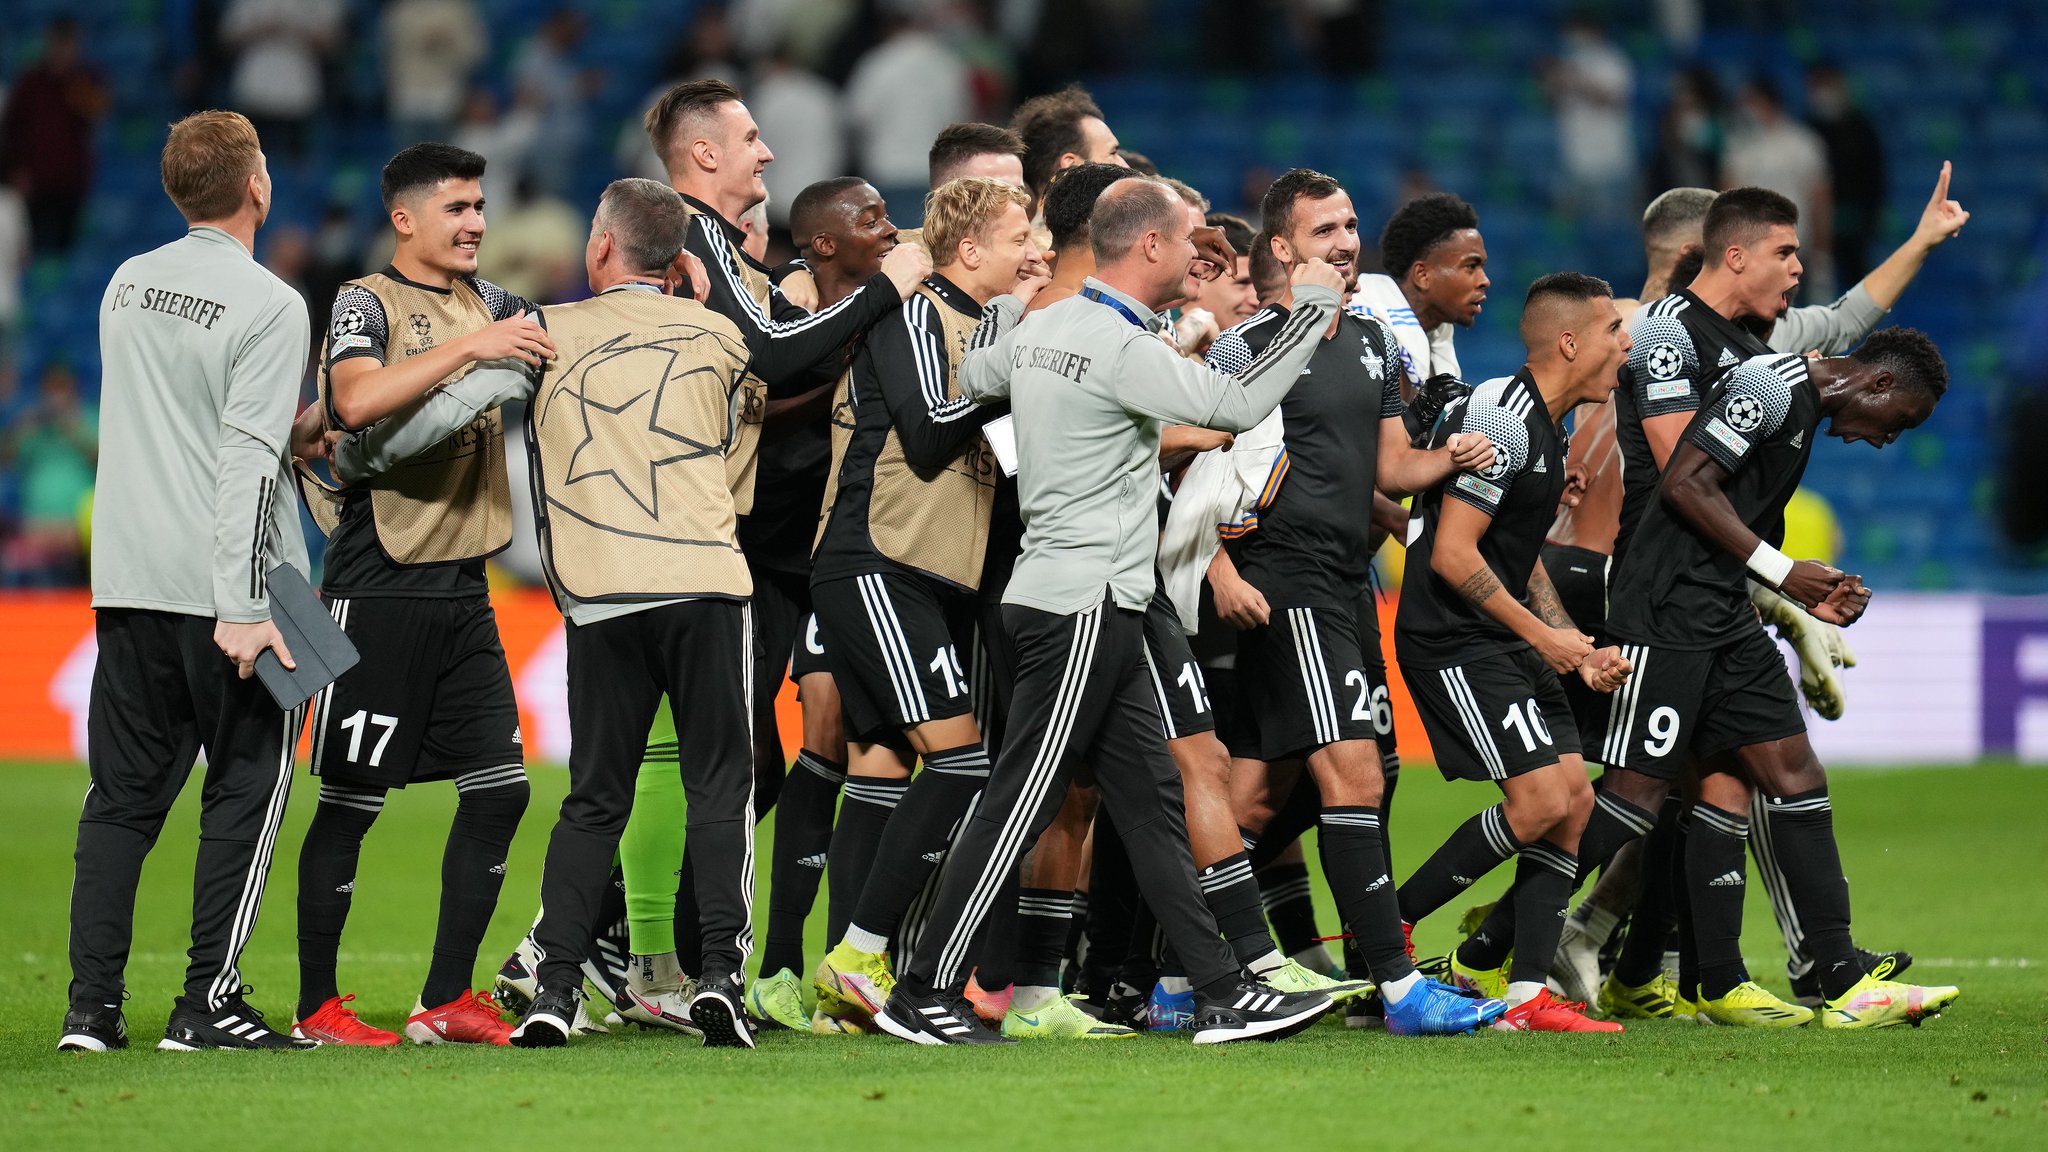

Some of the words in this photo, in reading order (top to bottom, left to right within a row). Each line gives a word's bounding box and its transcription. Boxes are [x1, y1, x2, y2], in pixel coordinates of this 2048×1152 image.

[111, 283, 135, 312] FC
[140, 287, 227, 331] SHERIFF
[1029, 346, 1092, 384] SHERIFF
[340, 709, 399, 767] 17
[1644, 705, 1681, 758] 9
